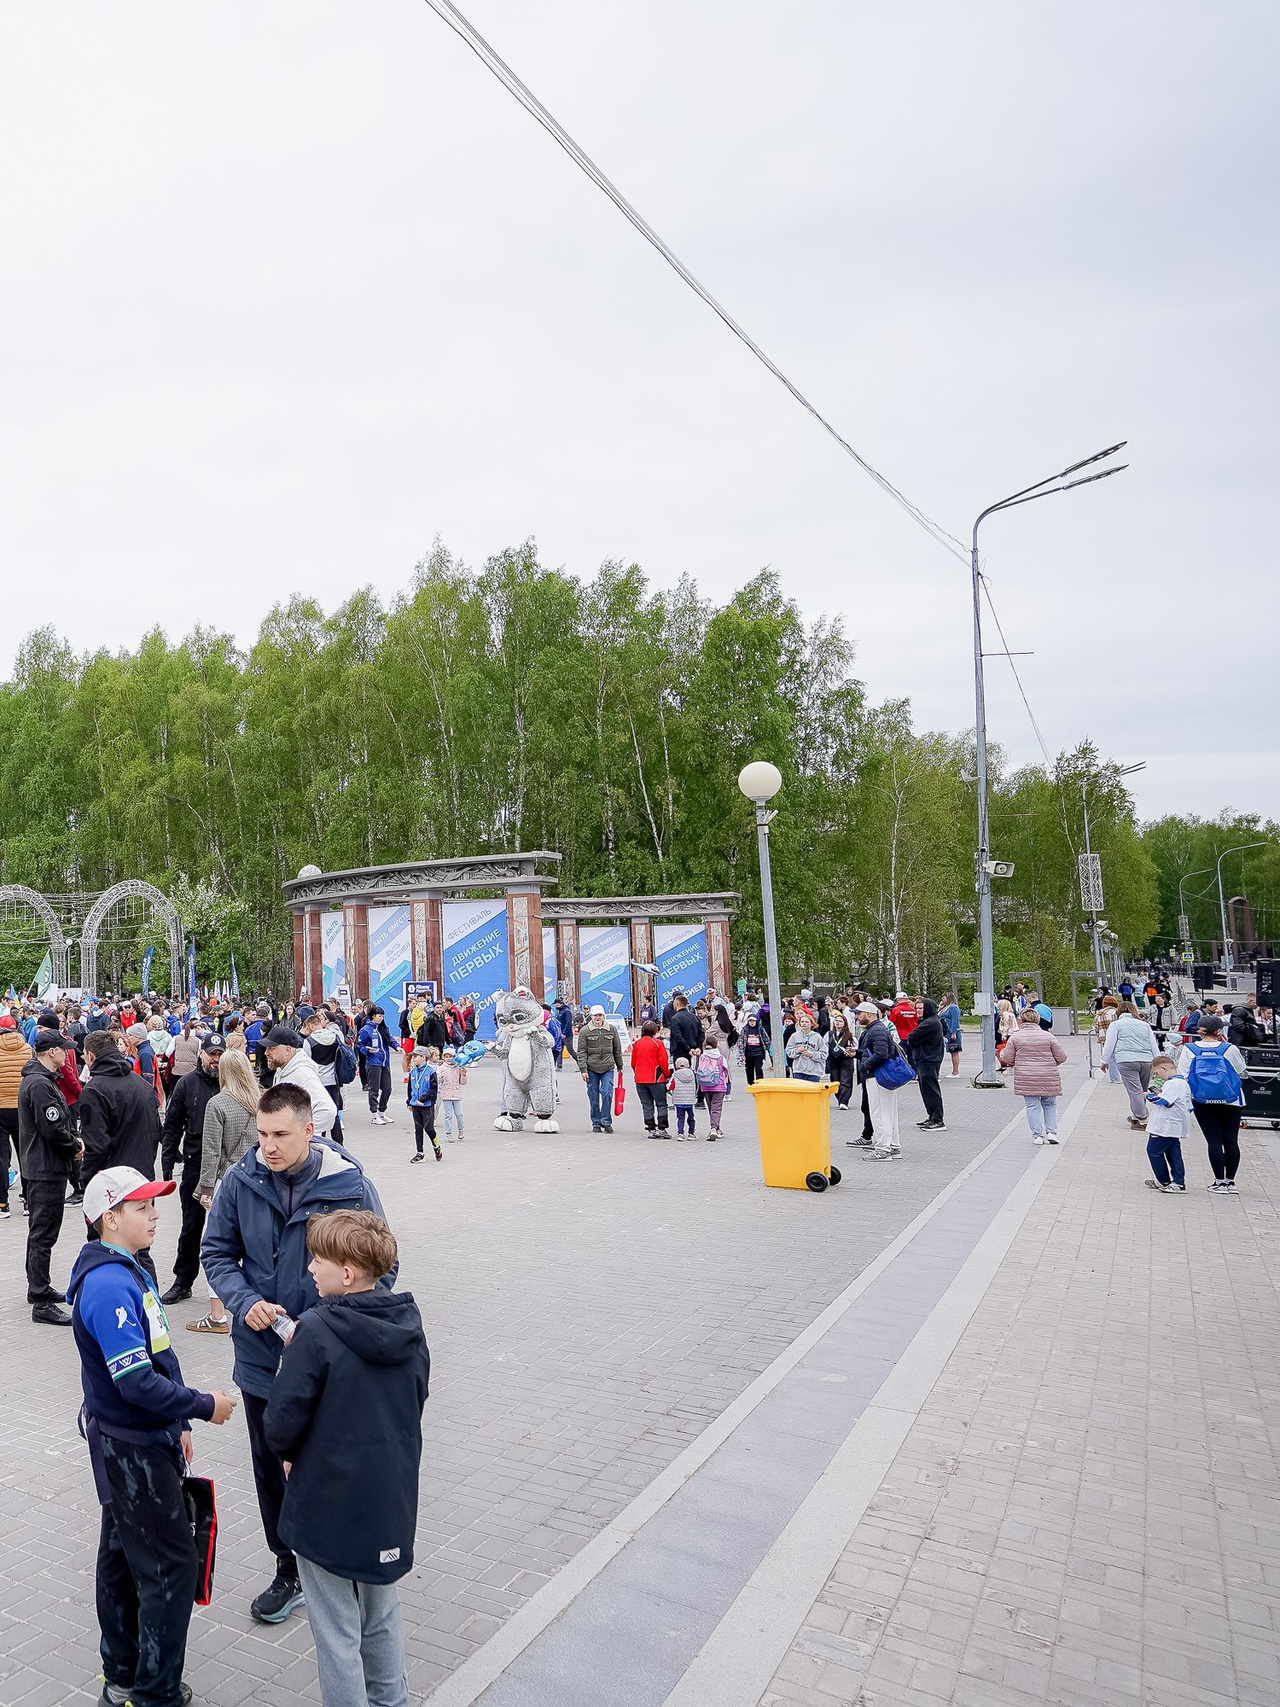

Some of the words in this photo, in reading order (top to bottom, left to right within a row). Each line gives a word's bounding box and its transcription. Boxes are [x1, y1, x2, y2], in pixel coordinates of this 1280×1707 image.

[373, 933, 389, 947] БЫТЬ
[388, 911, 410, 934] ВМЕСТЕ
[447, 908, 492, 940] ФЕСТИВАЛЬ
[386, 942, 401, 958] БЫТЬ
[387, 941, 411, 967] РОССИЕЙ
[451, 928, 502, 967] ДВИЖЕНИЕ
[583, 943, 600, 956] БЫТЬ
[599, 930, 624, 947] ВМЕСТЕ
[658, 929, 693, 951] ФЕСТИВАЛЬ
[448, 942, 504, 984] ПЕРВЫХ
[660, 951, 704, 981] ПЕРВЫХ
[661, 942, 701, 969] ДВИЖЕНИЕ
